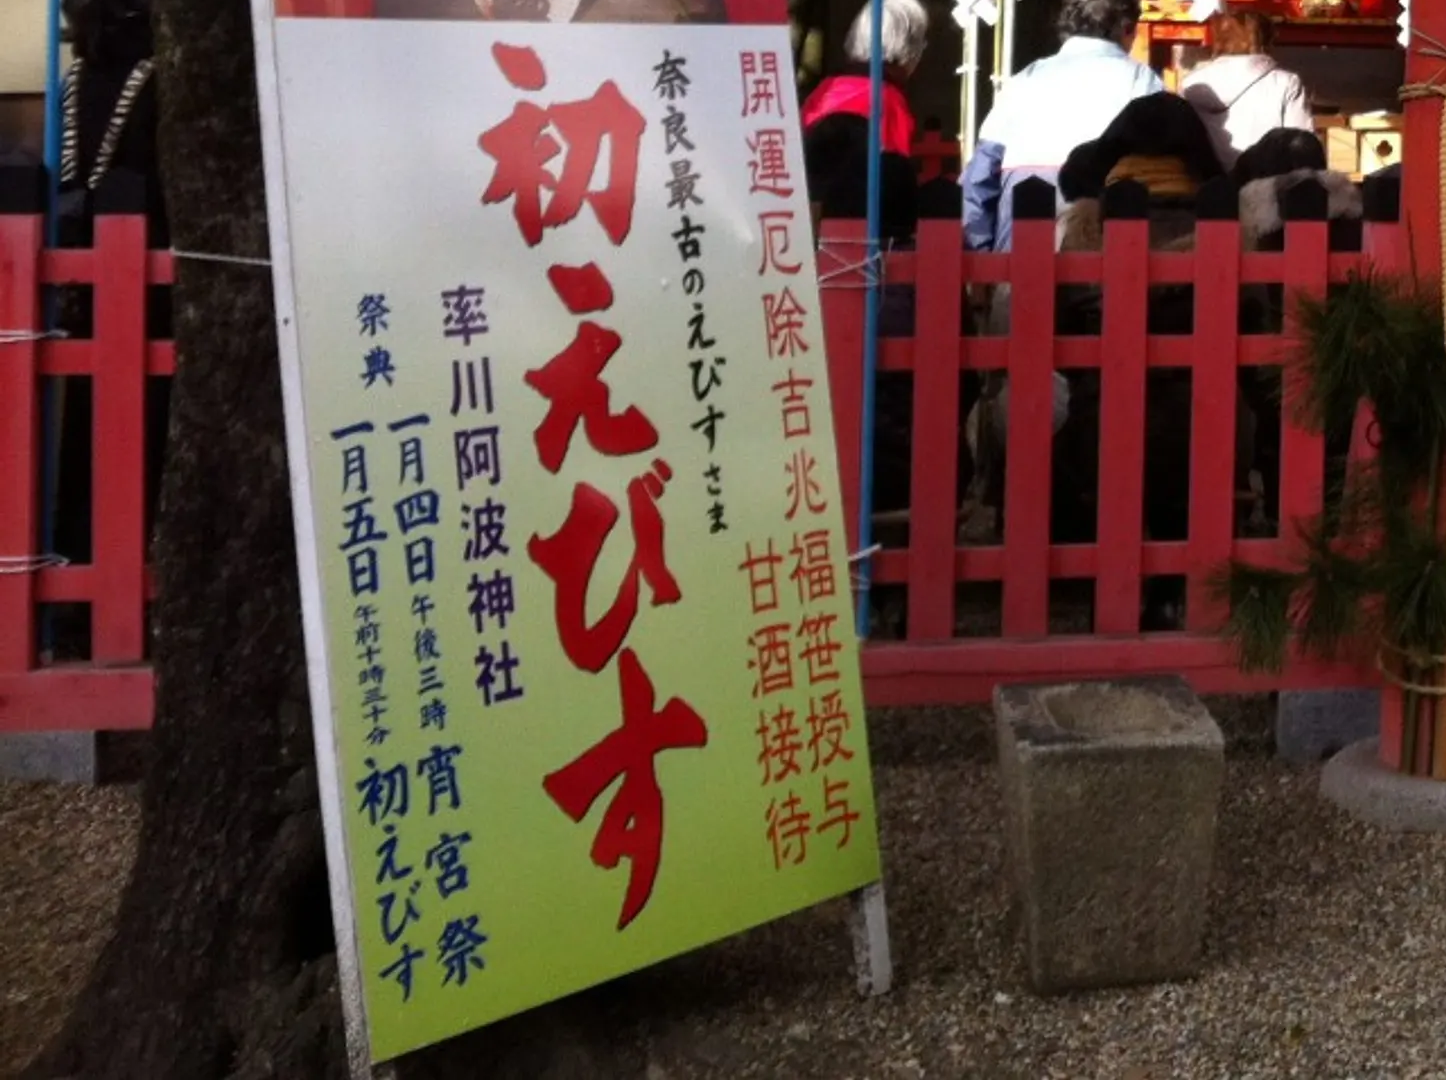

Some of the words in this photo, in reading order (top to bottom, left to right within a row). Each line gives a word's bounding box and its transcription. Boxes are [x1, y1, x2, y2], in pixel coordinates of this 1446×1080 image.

[354, 292, 397, 389] 祭典
[440, 284, 524, 706] 率川阿波神社
[477, 40, 708, 932] 初えびす
[652, 49, 729, 535] 奈良最古のえびすさま
[737, 538, 811, 872] 甘酒接待
